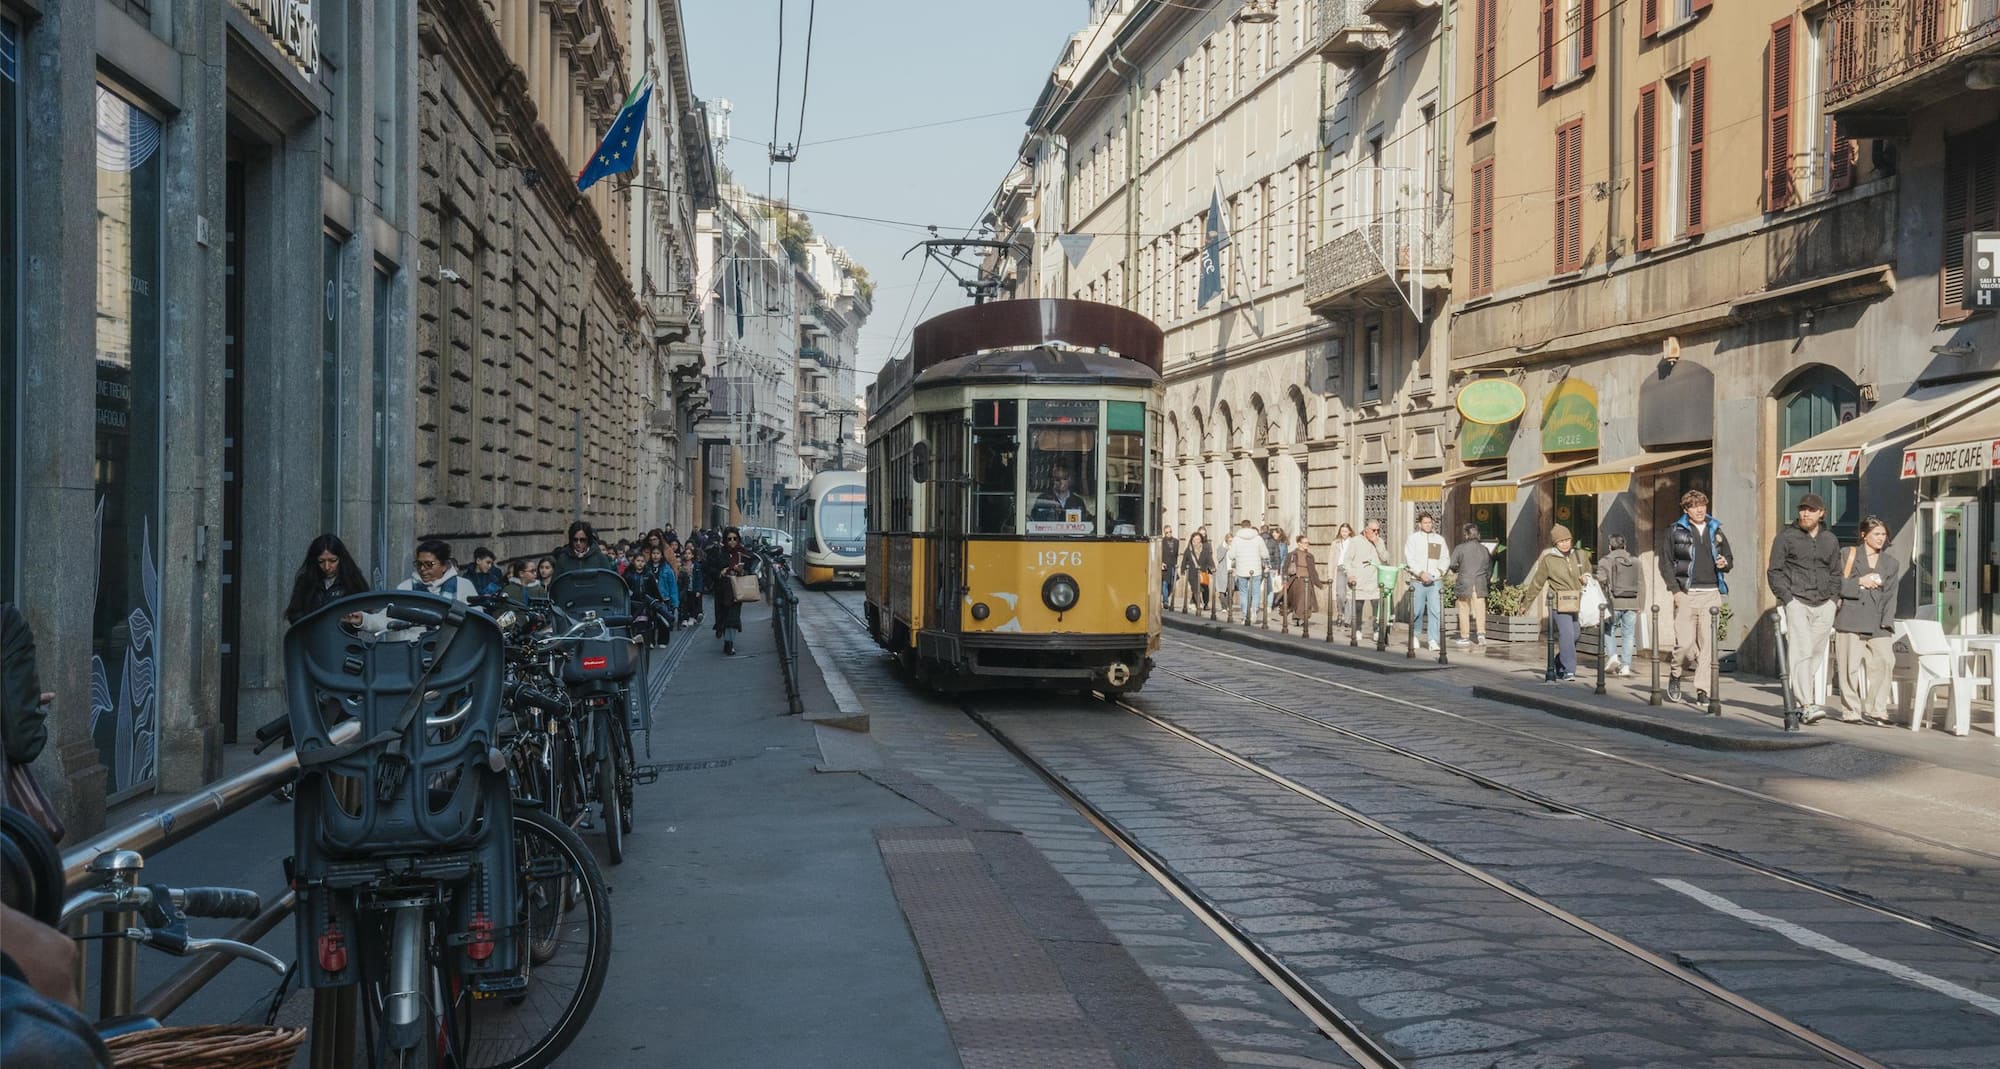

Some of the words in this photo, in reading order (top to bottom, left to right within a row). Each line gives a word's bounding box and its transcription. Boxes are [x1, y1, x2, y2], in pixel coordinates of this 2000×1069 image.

[1794, 456, 1823, 473] PIERRE
[1924, 450, 1957, 473] PIERRE
[1037, 551, 1082, 566] 1976
